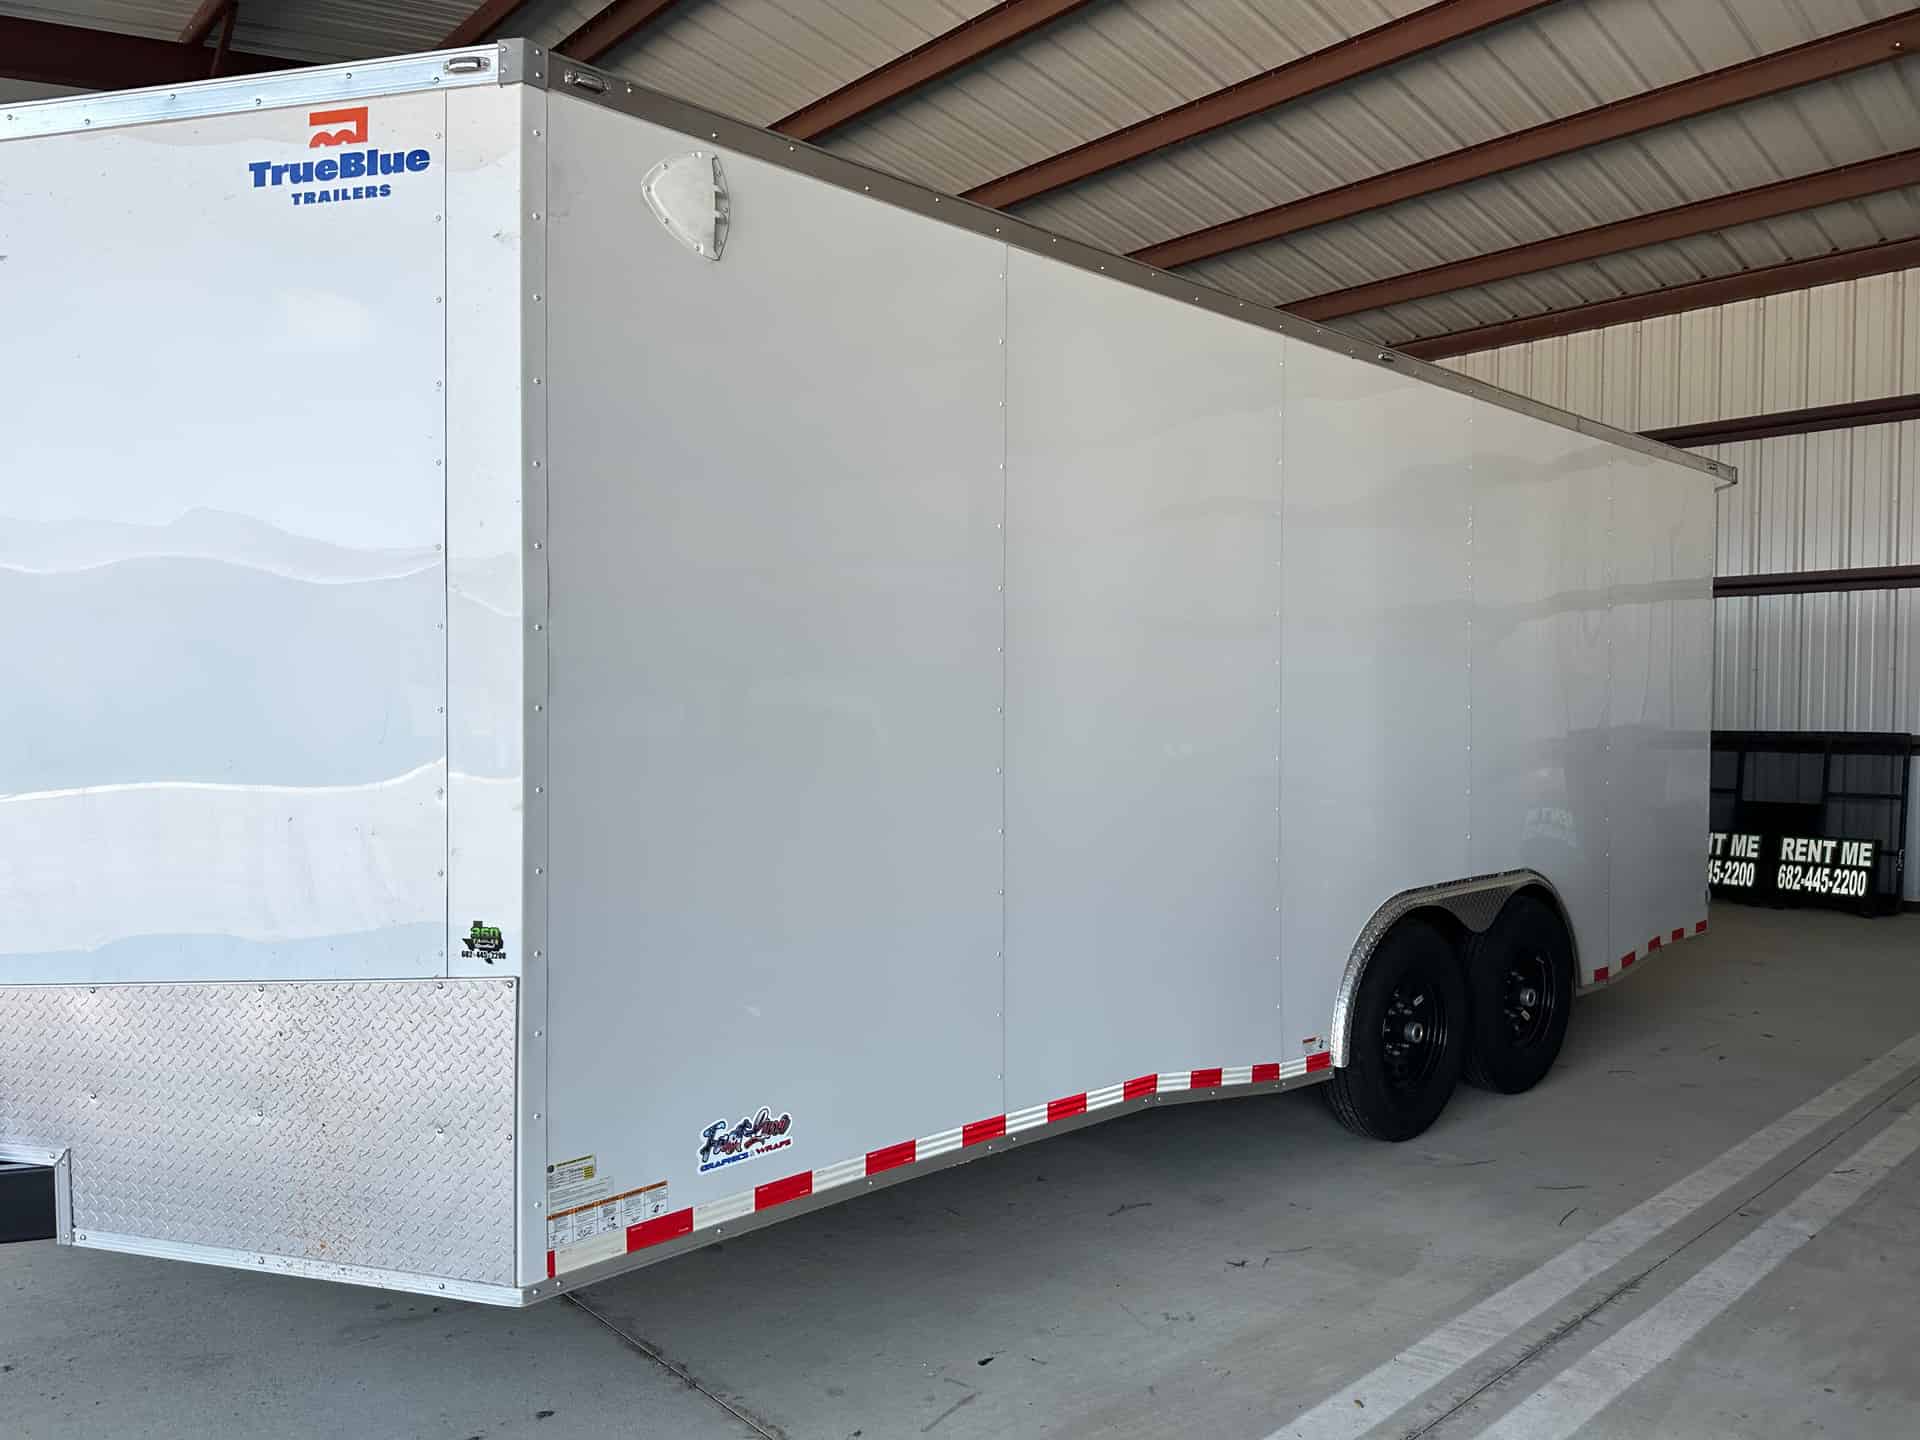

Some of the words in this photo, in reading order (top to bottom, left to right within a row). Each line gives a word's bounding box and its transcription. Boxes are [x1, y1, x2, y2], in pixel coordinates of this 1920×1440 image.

[249, 148, 431, 188] TrueBlue
[291, 184, 392, 206] TRAILERS
[1730, 834, 1761, 859] ME
[1781, 837, 1837, 864] RENT
[1840, 841, 1873, 867] ME
[1777, 864, 1867, 897] 682-445-2200
[755, 1138, 792, 1154] WRAPS
